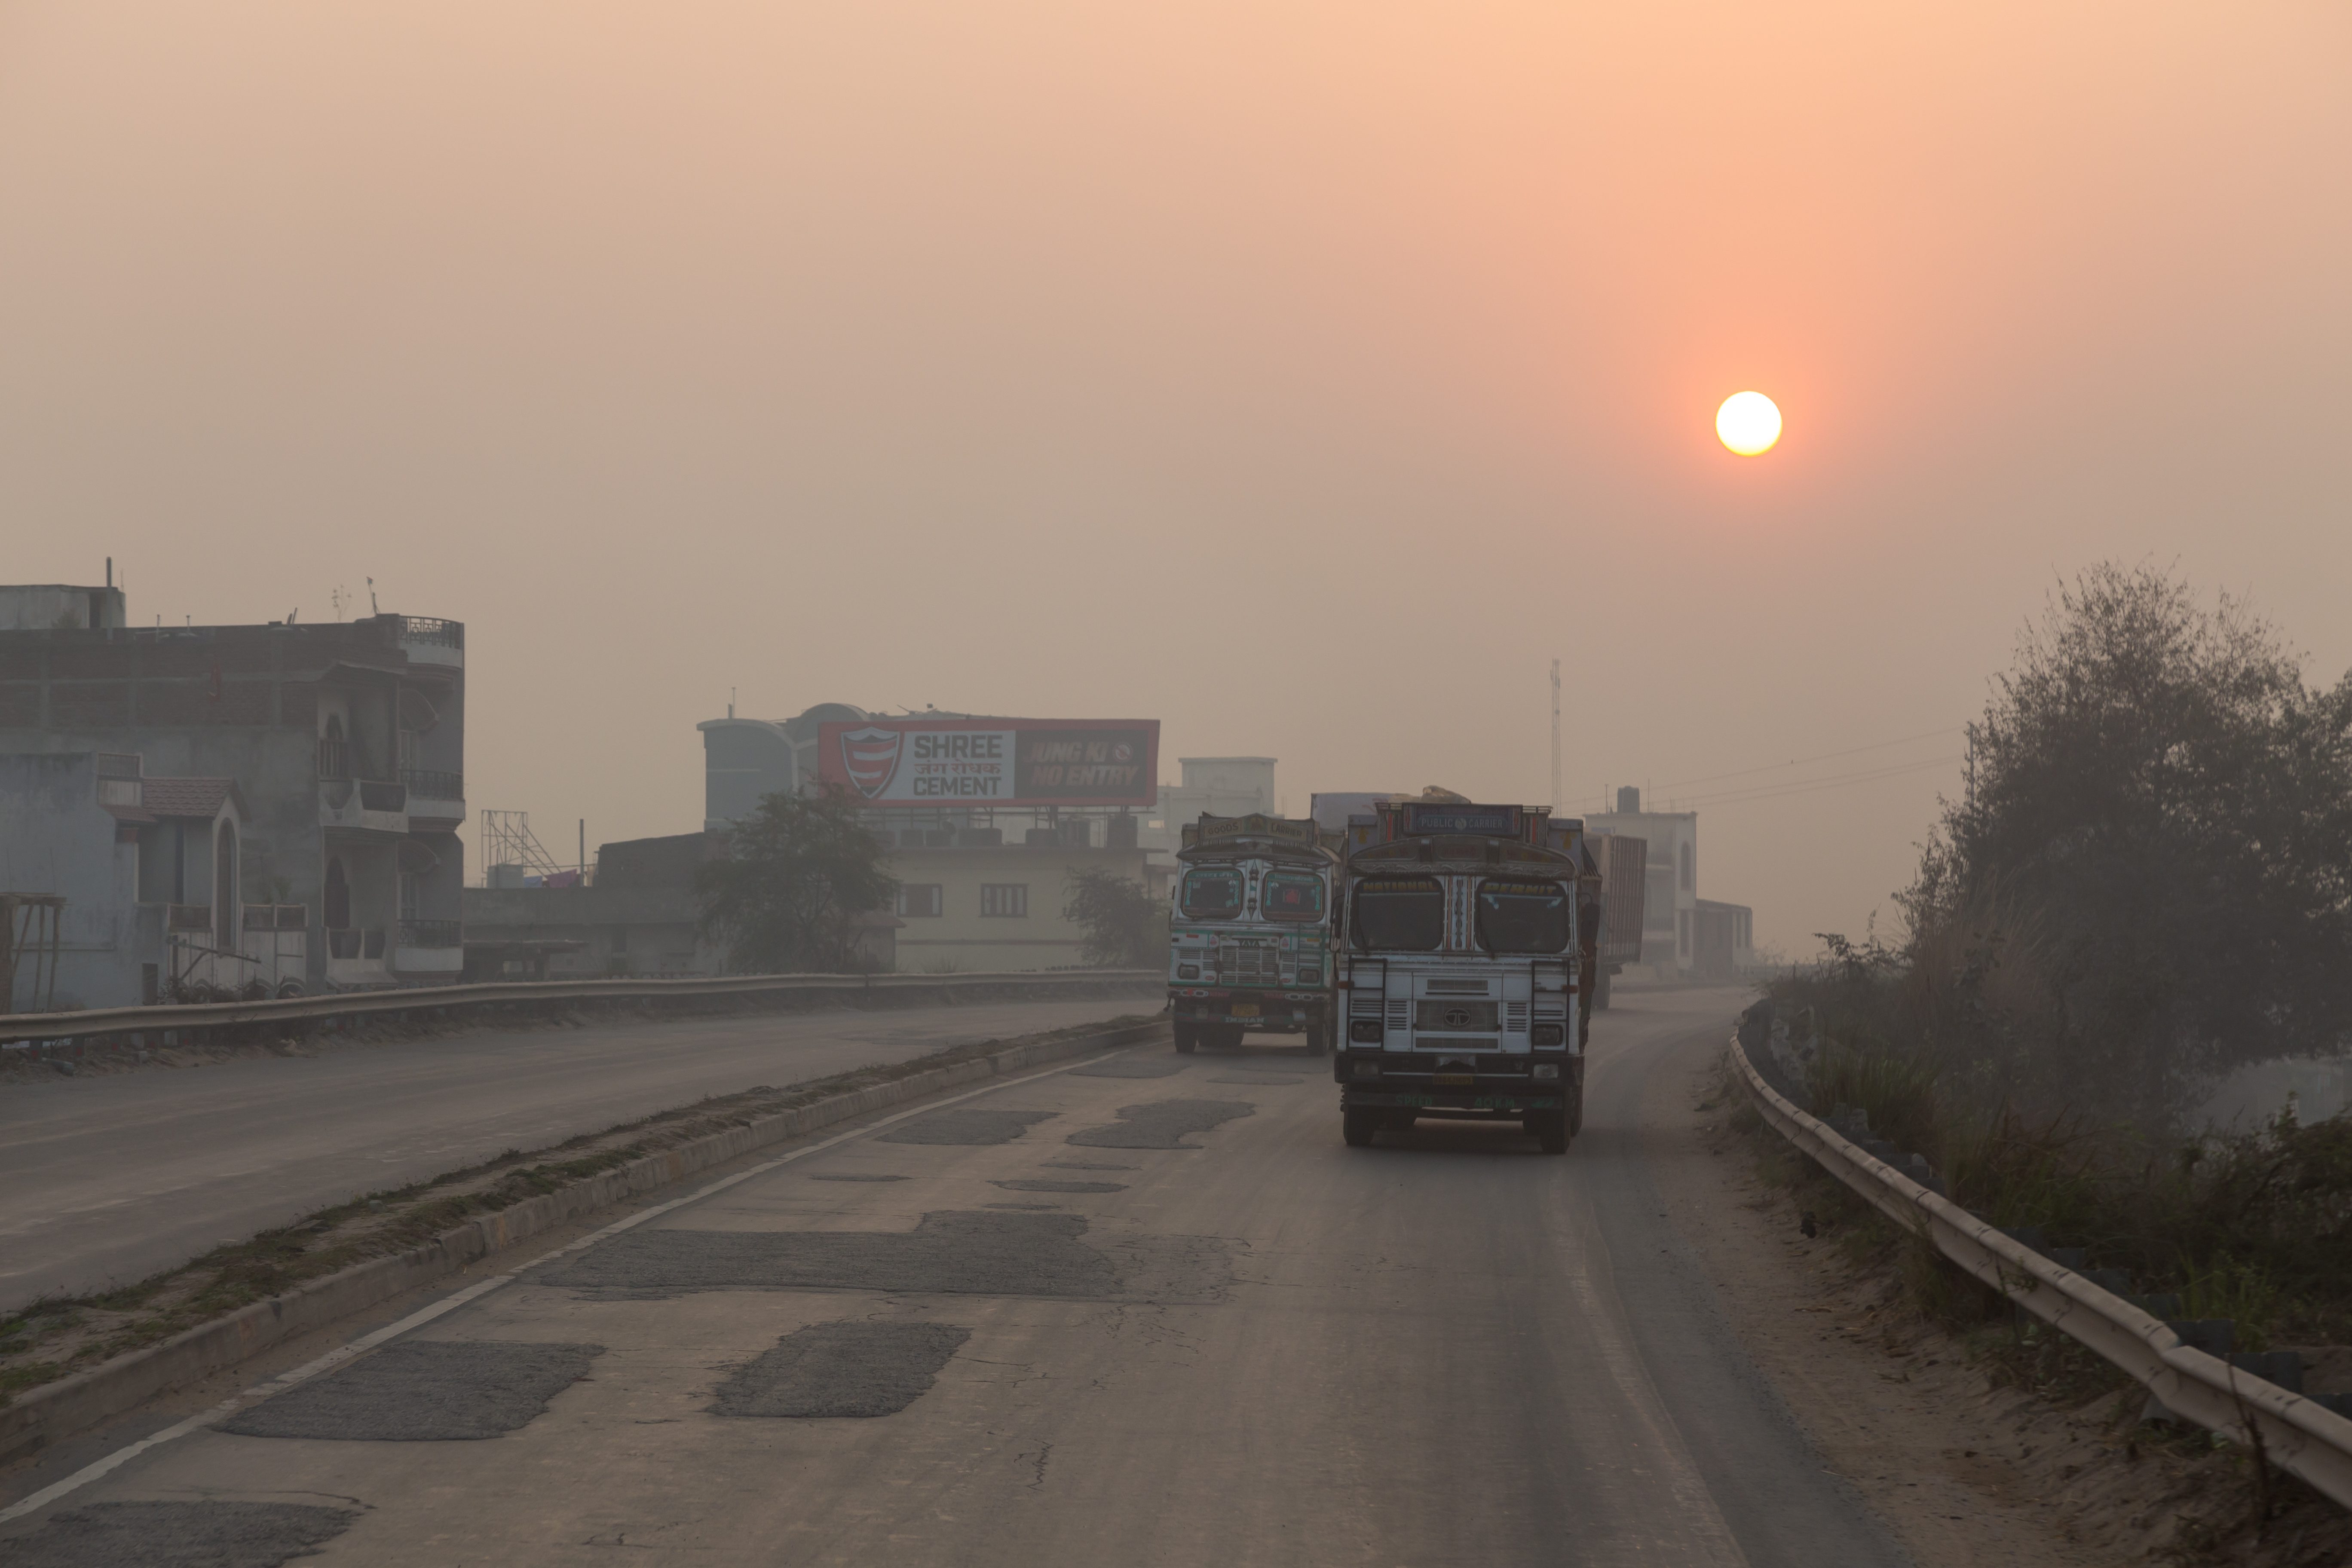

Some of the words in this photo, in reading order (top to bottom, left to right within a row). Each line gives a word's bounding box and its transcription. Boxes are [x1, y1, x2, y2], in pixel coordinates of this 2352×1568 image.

[914, 735, 1003, 758] SHREE
[1023, 742, 1082, 762] JUNG
[1086, 742, 1109, 762] KI
[914, 759, 948, 774] जंग
[950, 758, 1002, 775] रोधक
[1031, 765, 1063, 786] NO
[1066, 765, 1139, 786] ENTRY
[914, 776, 1002, 795] CEMENT
[1208, 822, 1239, 835] GOODS
[1271, 823, 1302, 837] CARRIER
[1421, 818, 1453, 827] PUBLIC
[1469, 818, 1503, 828] CARRIER
[1363, 881, 1438, 892] NATIONAL
[1484, 882, 1556, 894] PERMIT
[1396, 1094, 1433, 1106] SPEED
